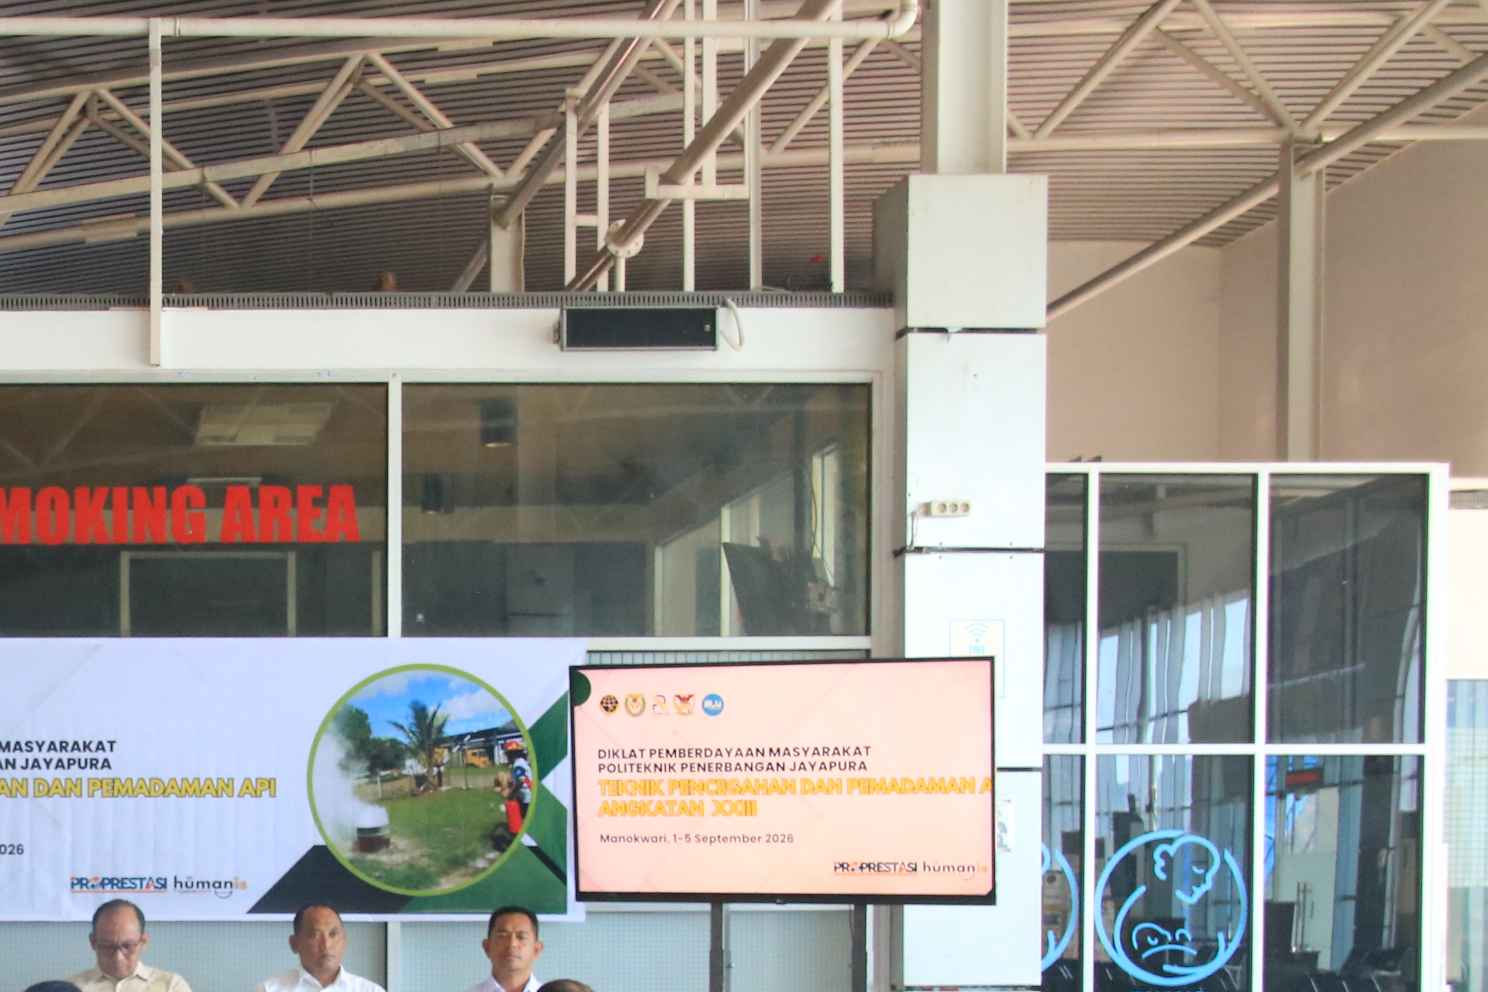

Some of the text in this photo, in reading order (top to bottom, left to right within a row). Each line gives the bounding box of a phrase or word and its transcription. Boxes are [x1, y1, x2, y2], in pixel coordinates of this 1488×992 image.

[220, 484, 361, 544] AREA
[597, 746, 872, 759] DIKLAT PEMBERDAYAAN MASYARAKAT
[20, 757, 112, 770] JAYAPURA
[598, 761, 868, 773] POLITEKNIK PENERBANGAN JAYAPURA
[33, 777, 82, 798] DAN
[87, 777, 234, 798] PEMADAMAN
[238, 777, 277, 798] API
[598, 779, 664, 796] TEKNIK
[668, 778, 796, 796] PENCEGAHAN
[799, 777, 843, 795] DAN
[847, 777, 976, 795] PEMADAMAN
[598, 799, 705, 817] ANGKATAN
[673, 833, 692, 843] 1-5
[695, 833, 762, 846] September
